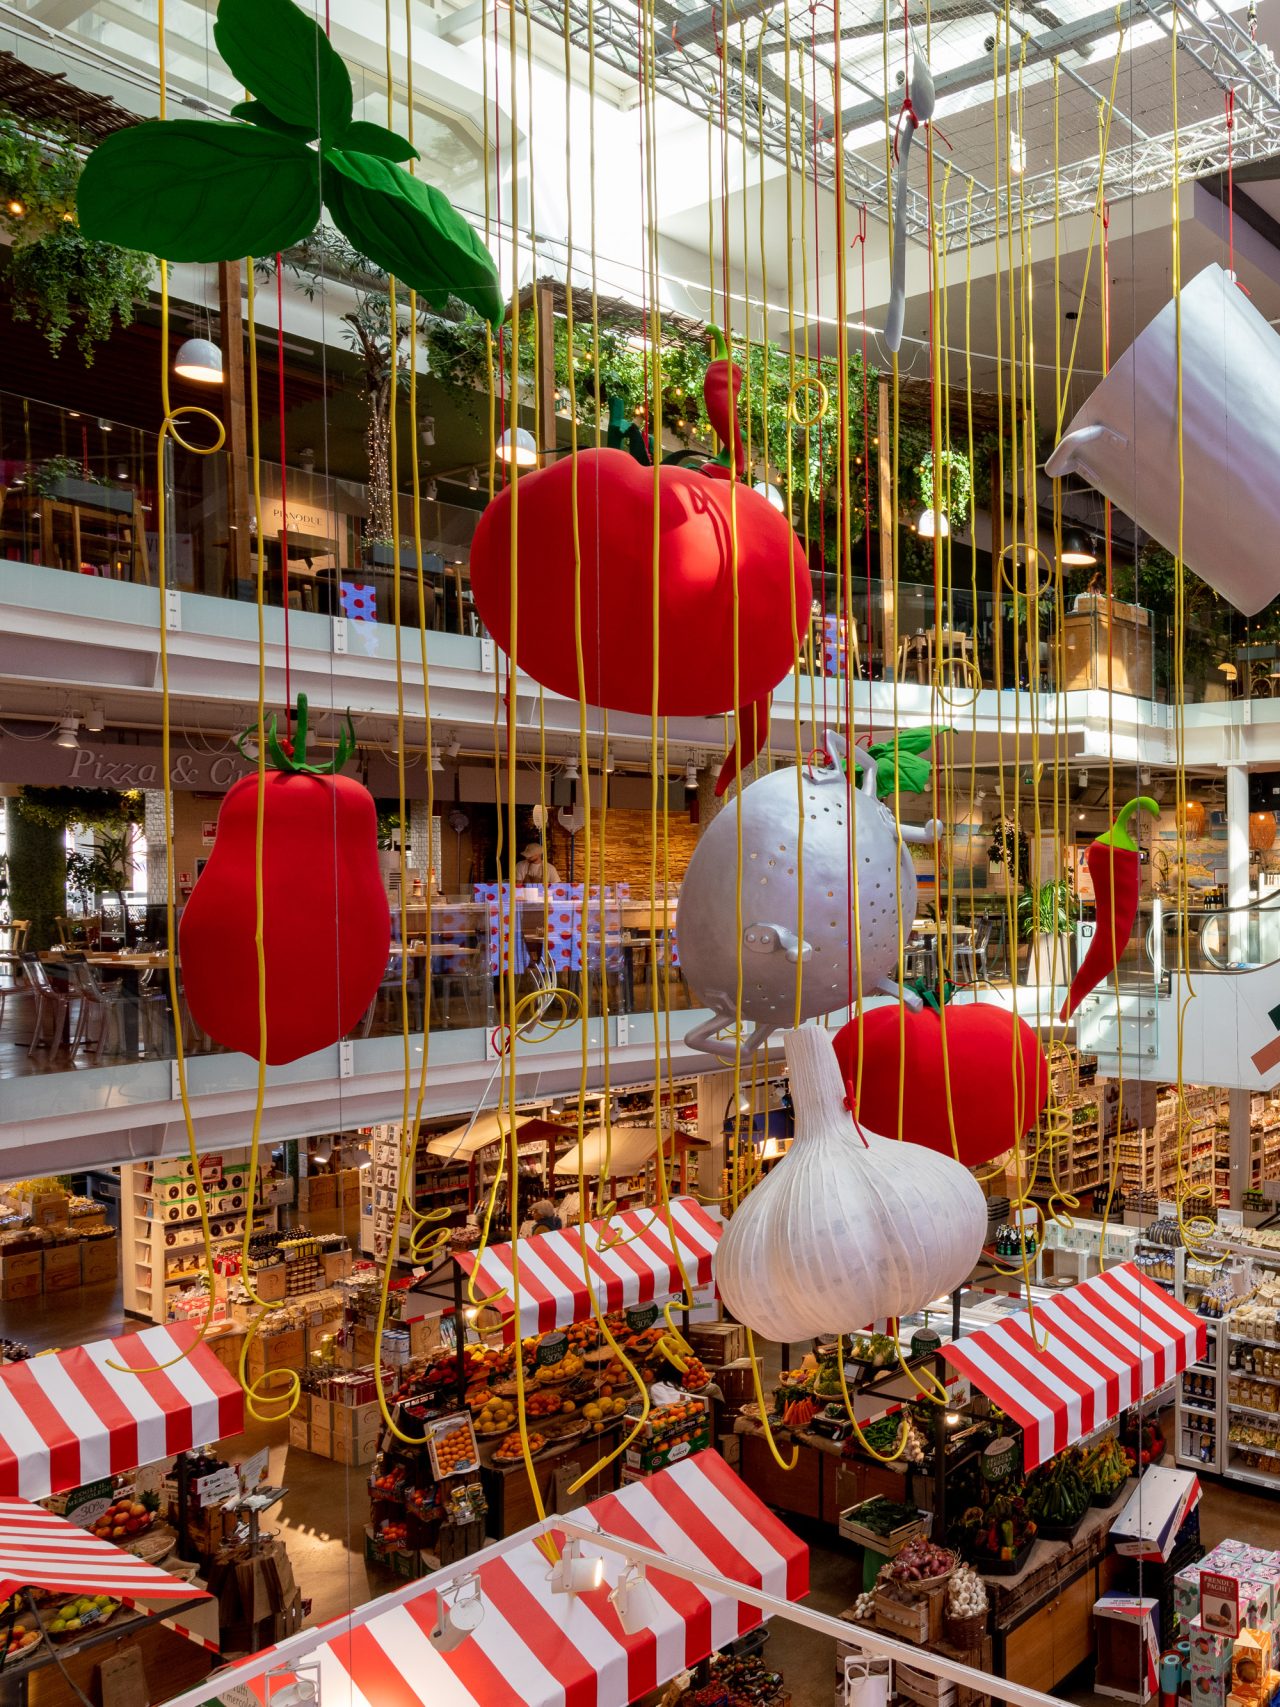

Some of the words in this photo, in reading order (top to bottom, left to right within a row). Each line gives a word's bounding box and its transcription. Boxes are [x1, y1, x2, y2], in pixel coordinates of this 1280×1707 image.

[68, 749, 157, 785] Pizza
[171, 755, 198, 785] &
[1204, 1576, 1230, 1587] PRENDI
[1207, 1583, 1227, 1592] PAGHI
